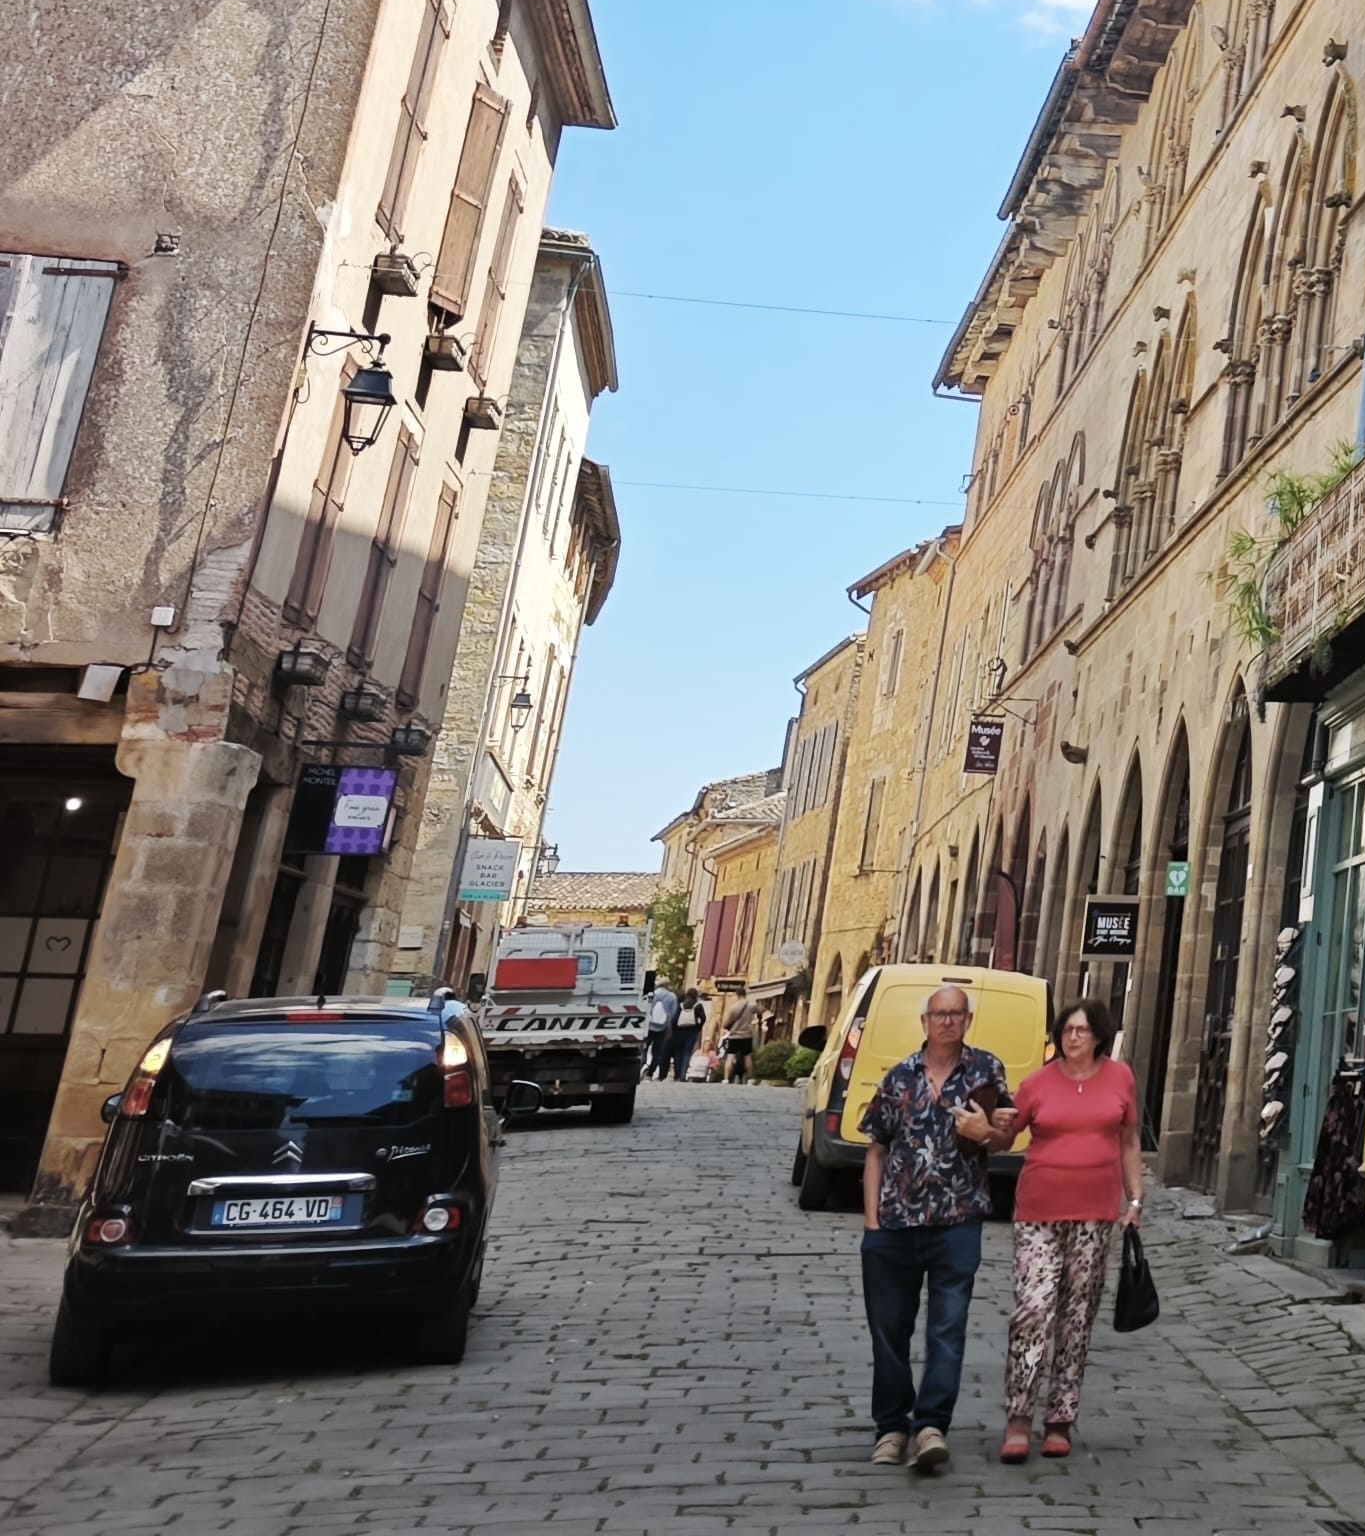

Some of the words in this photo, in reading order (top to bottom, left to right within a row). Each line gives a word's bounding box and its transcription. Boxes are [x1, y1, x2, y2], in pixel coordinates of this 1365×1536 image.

[971, 724, 1001, 735] Musée
[1097, 914, 1131, 929] MUSÉE
[496, 1015, 646, 1032] CANTER
[226, 1198, 331, 1223] CG-464-VD
